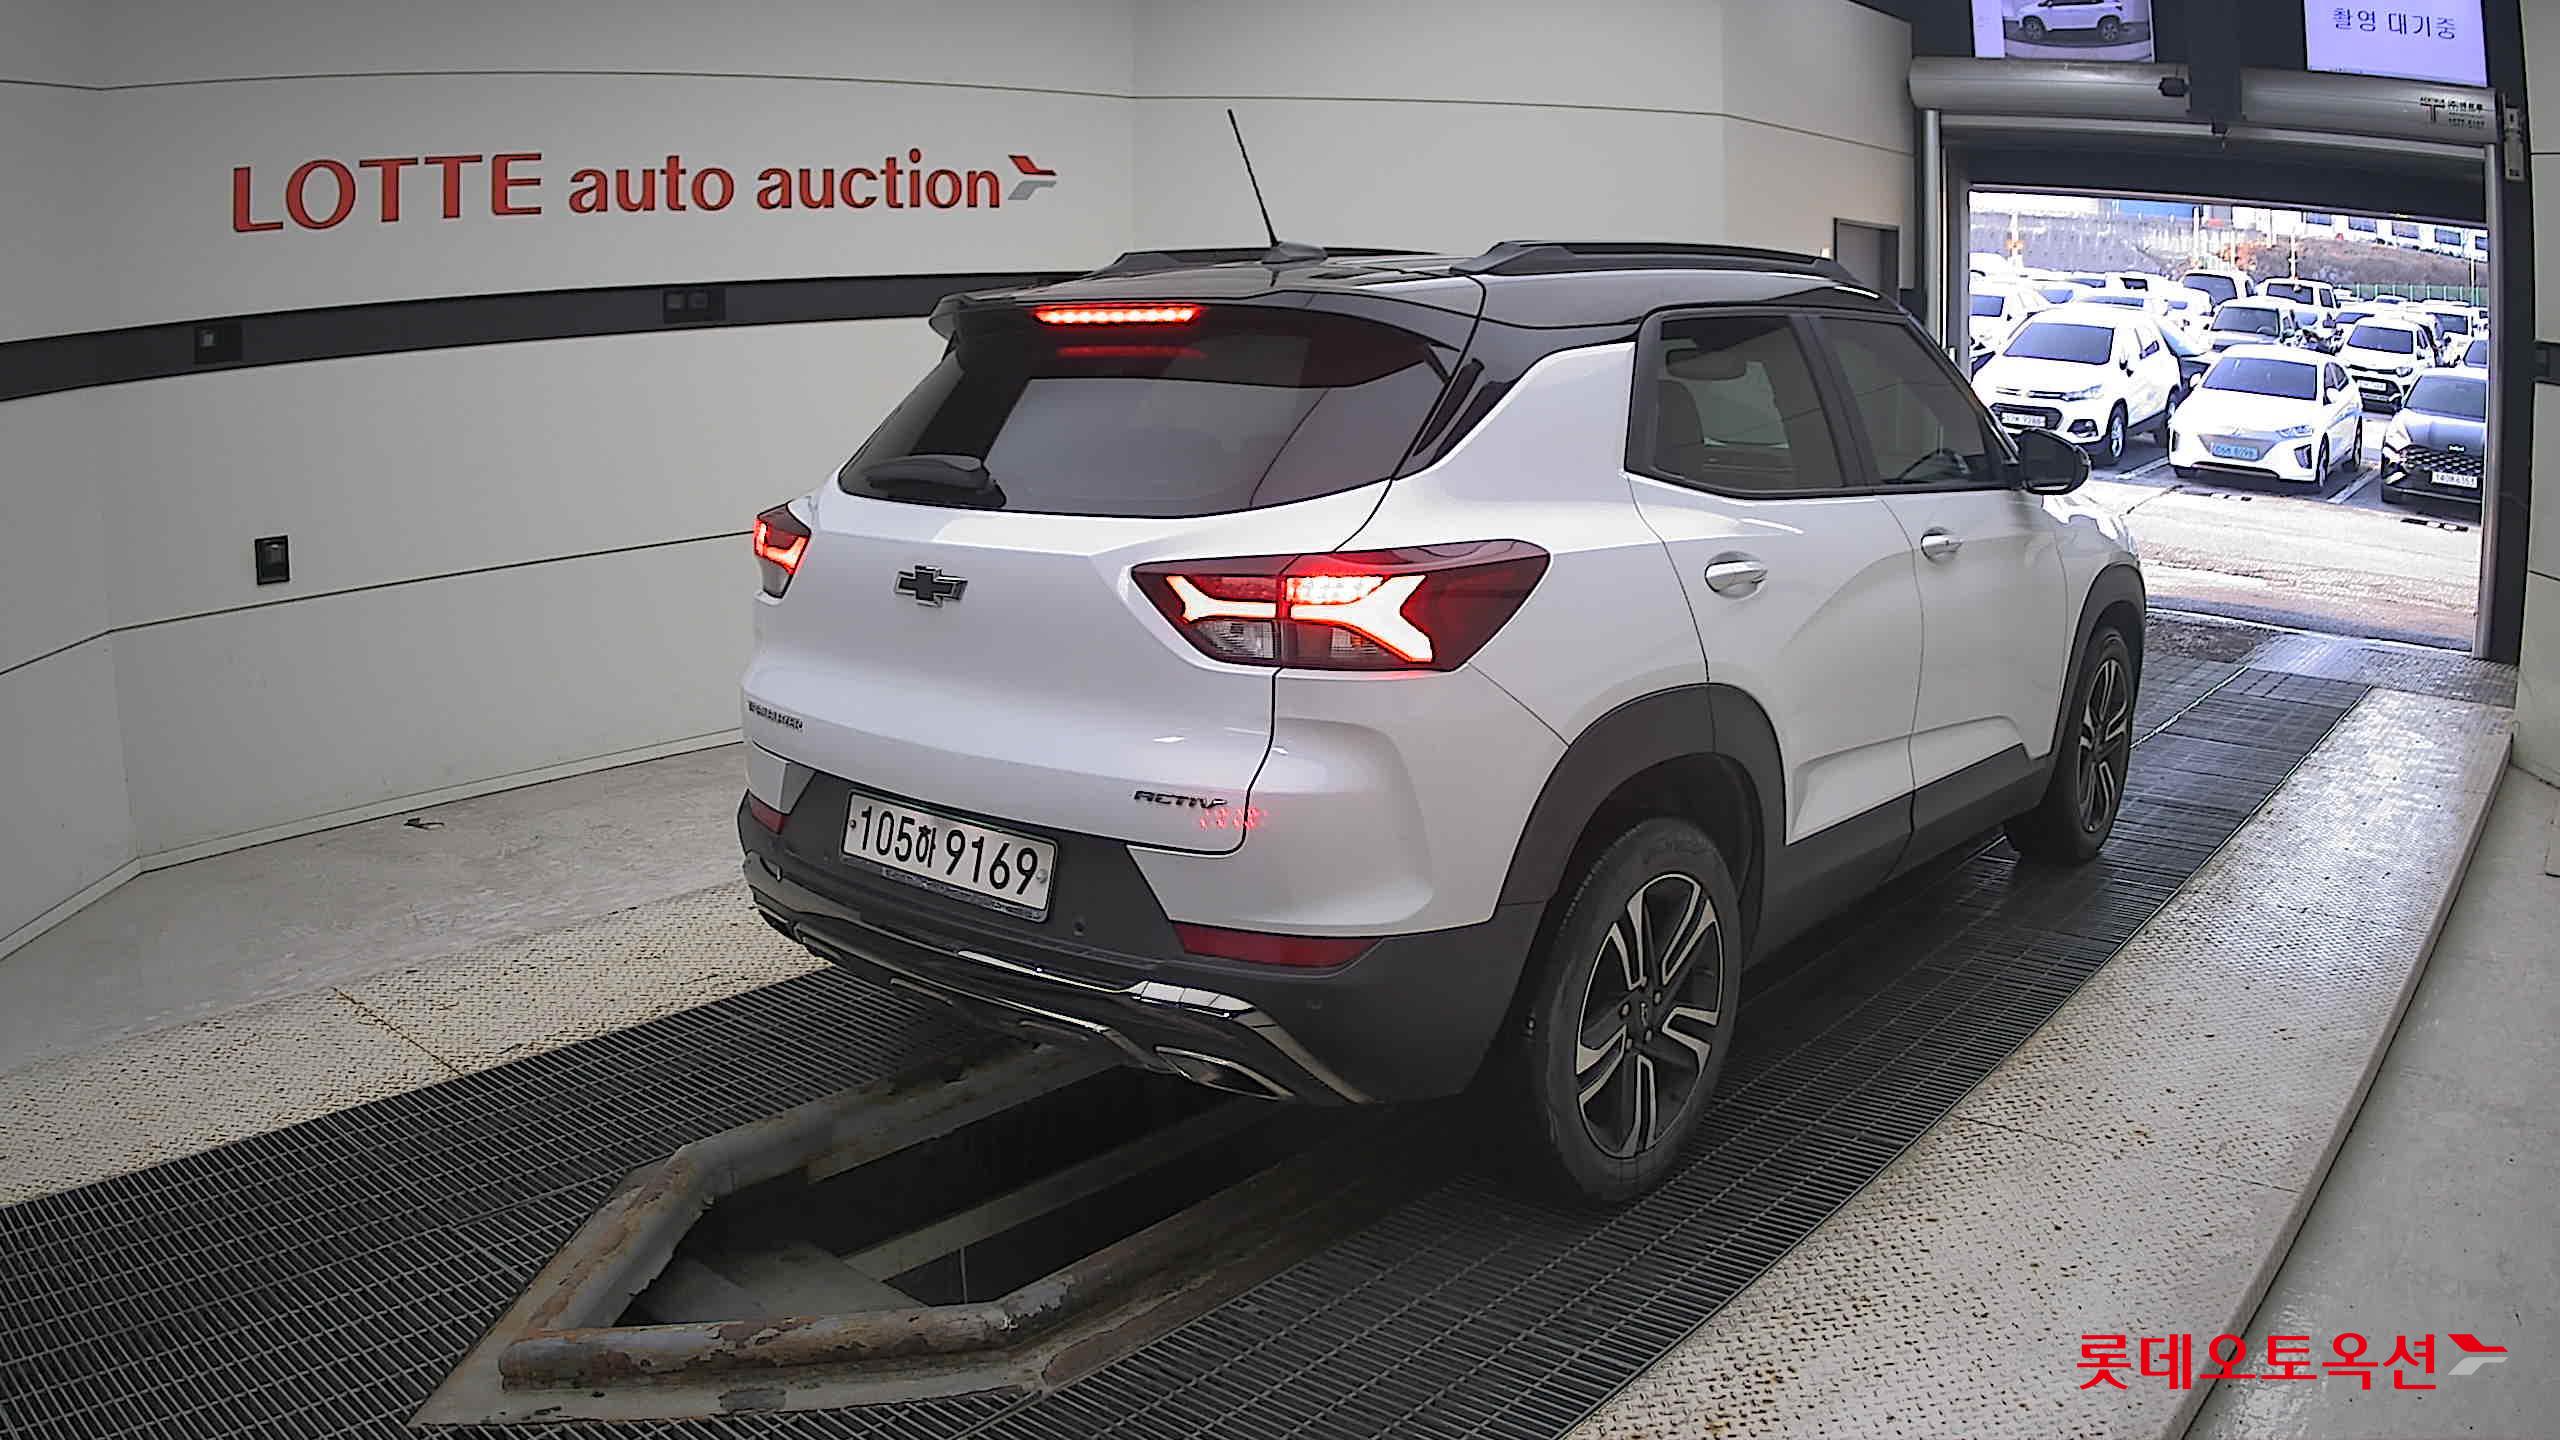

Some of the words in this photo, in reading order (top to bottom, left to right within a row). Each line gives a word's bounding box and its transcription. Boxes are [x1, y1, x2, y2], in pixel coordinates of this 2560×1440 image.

[2333, 7, 2377, 32] 촬영
[2387, 12, 2457, 40] 대기중
[233, 153, 541, 233] LOTTE
[568, 154, 737, 215] auto
[757, 149, 1003, 211] auction
[860, 805, 937, 869] 105하
[945, 828, 1039, 896] 9169
